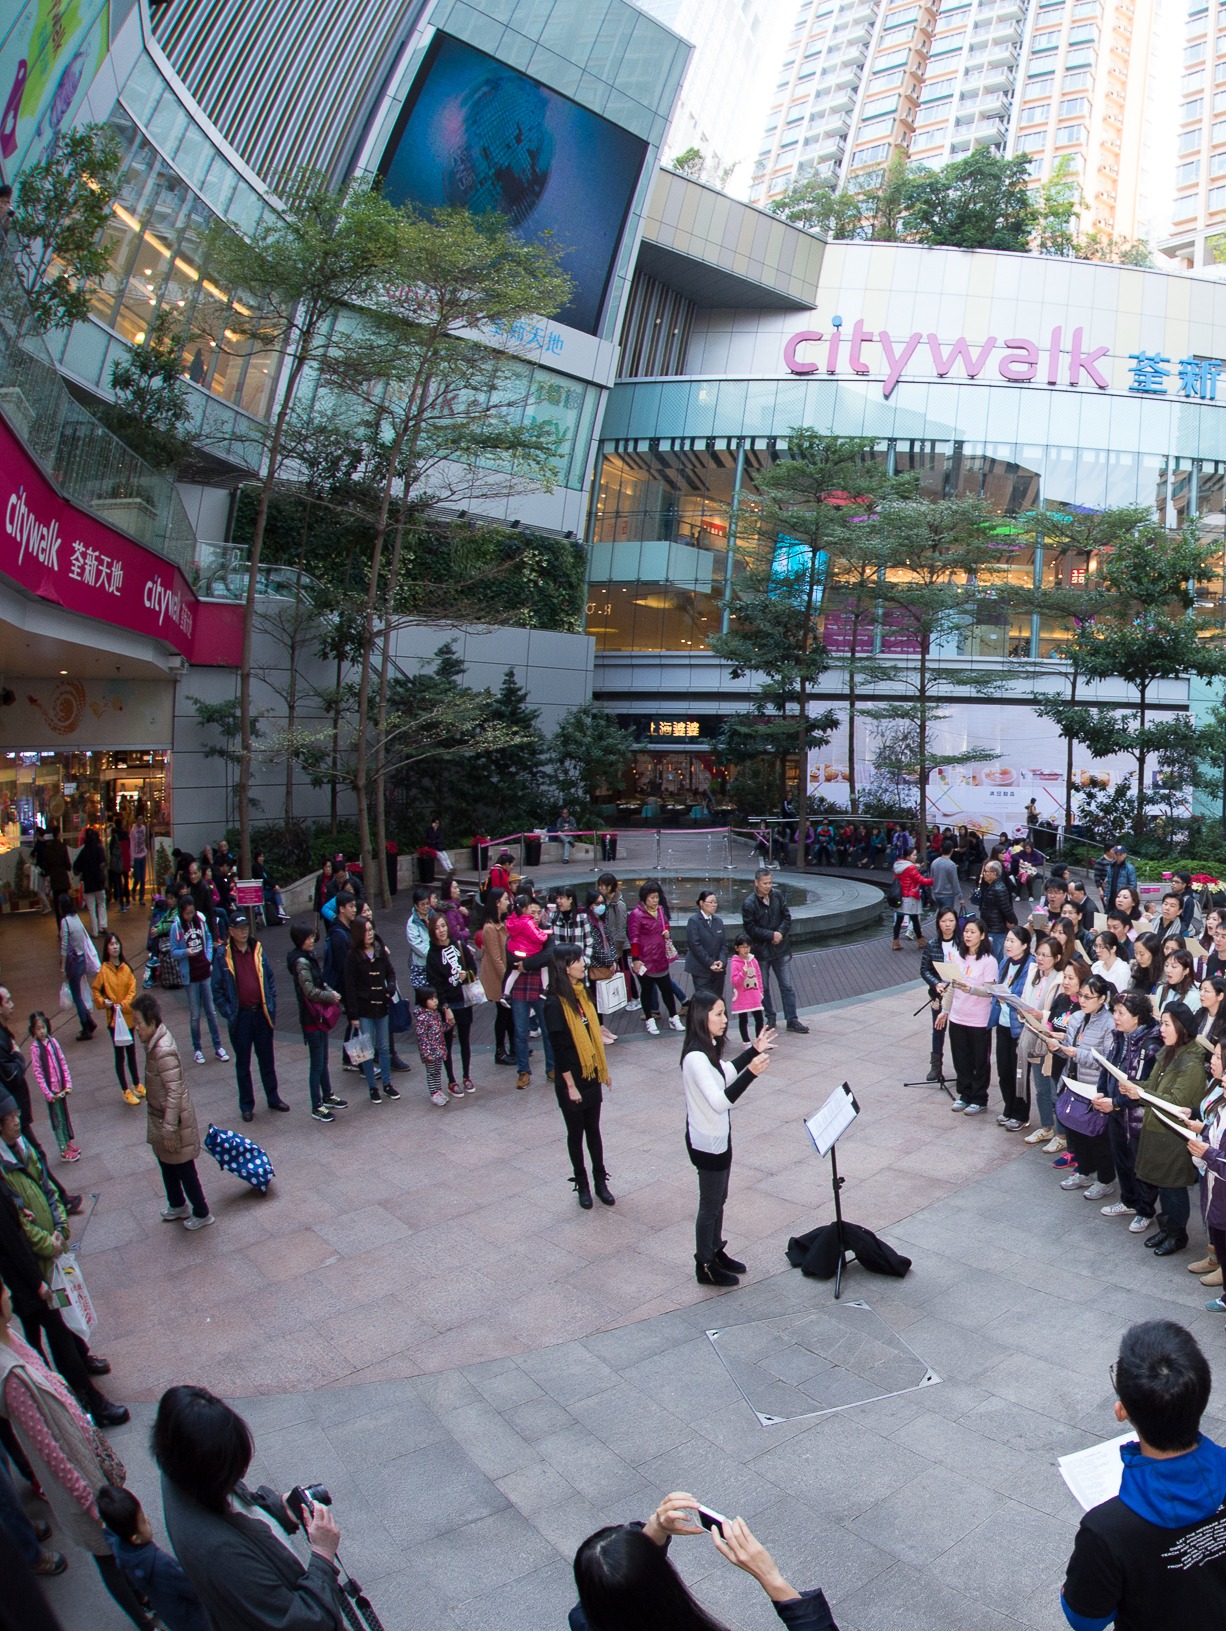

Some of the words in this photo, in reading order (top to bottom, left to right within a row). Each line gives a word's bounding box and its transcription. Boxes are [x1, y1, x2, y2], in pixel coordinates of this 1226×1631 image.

[783, 314, 1110, 399] citywalk
[5, 485, 62, 572] citywalk
[68, 540, 124, 597] 荃新天地
